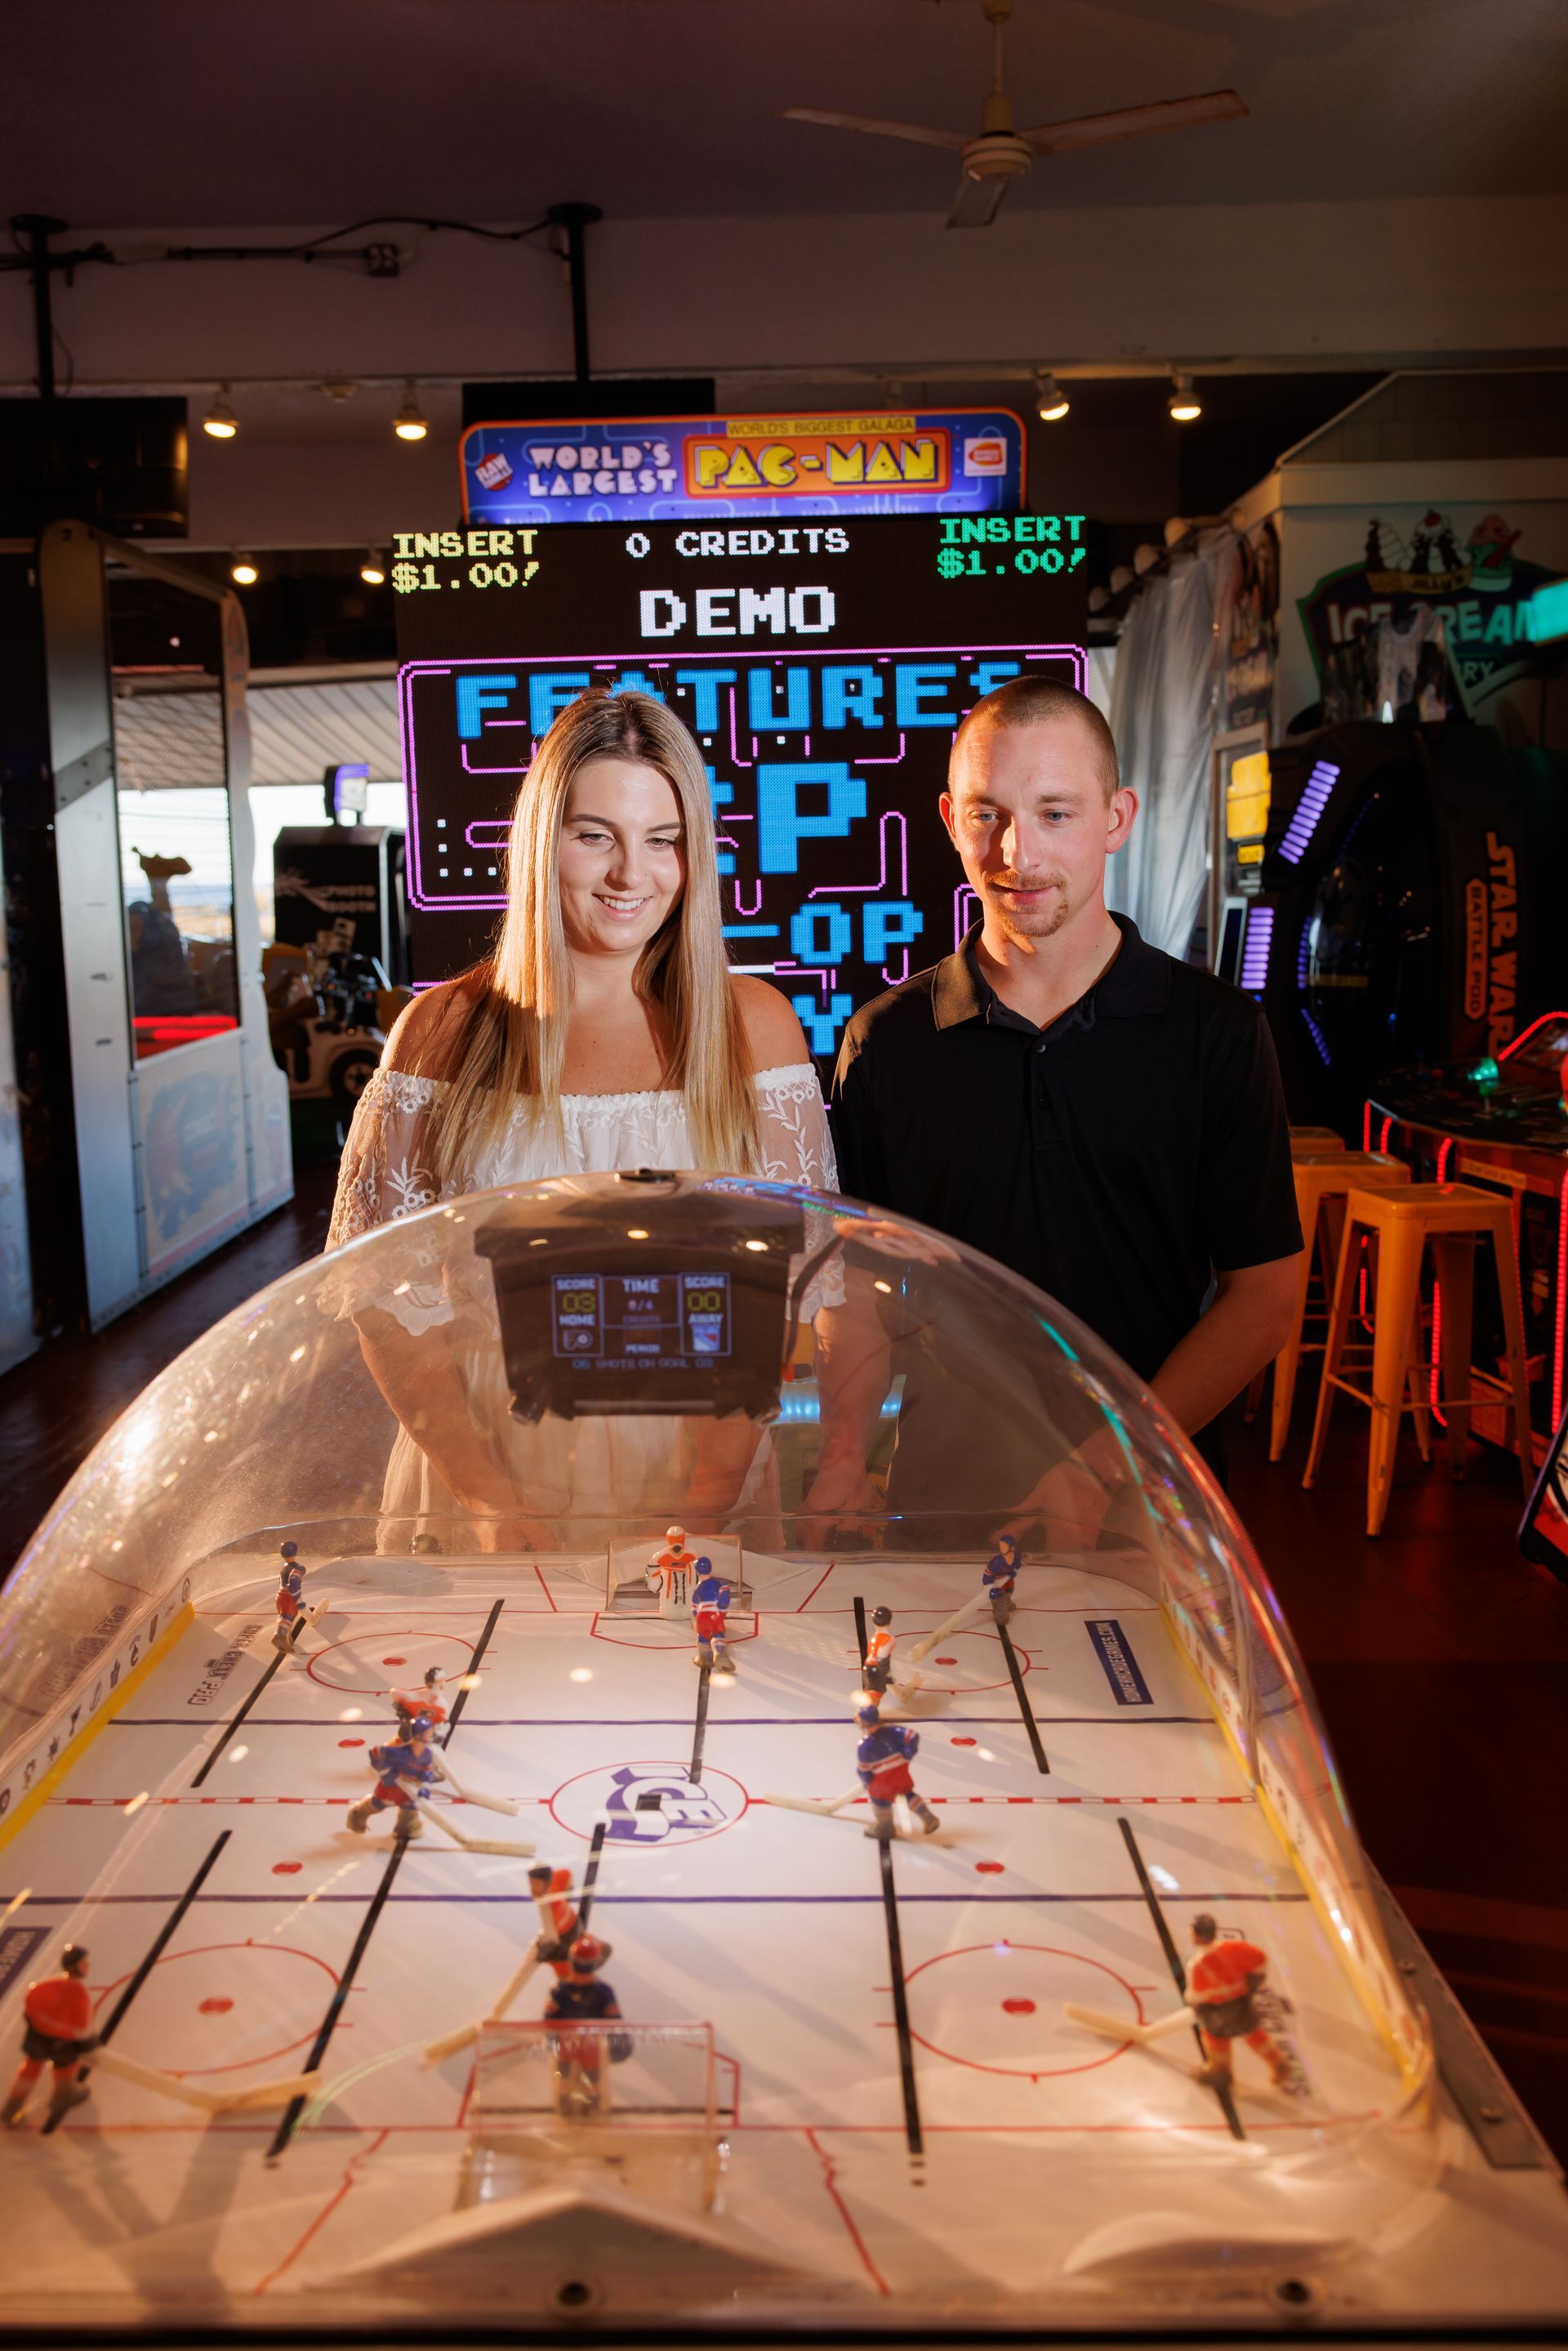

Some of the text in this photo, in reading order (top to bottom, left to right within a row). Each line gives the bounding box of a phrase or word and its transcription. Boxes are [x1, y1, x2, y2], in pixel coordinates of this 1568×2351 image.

[728, 417, 914, 436] WORLD'S BIGGEST GALAGA
[529, 441, 671, 471] WORLD'S
[694, 439, 939, 488] PAC-MAN
[528, 469, 677, 497] LARGEST
[939, 515, 1086, 543] INSERT
[393, 529, 538, 559] INSERT
[626, 528, 850, 558] 0 CREDITS
[937, 547, 1086, 579] $1.00!
[391, 562, 540, 594] $1.00!
[639, 586, 835, 637] DEMO
[1470, 886, 1482, 1013] BATTLE POD
[1486, 831, 1517, 1061] STAR WAR
[556, 1278, 596, 1291] SCORE
[622, 1278, 660, 1293] TIME
[684, 1276, 725, 1288] SCORE
[562, 1292, 596, 1313] 03
[687, 1291, 721, 1312] 00
[559, 1314, 595, 1326] HOME
[688, 1313, 723, 1324] AWAY
[626, 1344, 660, 1354] PERIOD
[229, 1624, 264, 1649] SUPER
[186, 1680, 225, 1706] PRO
